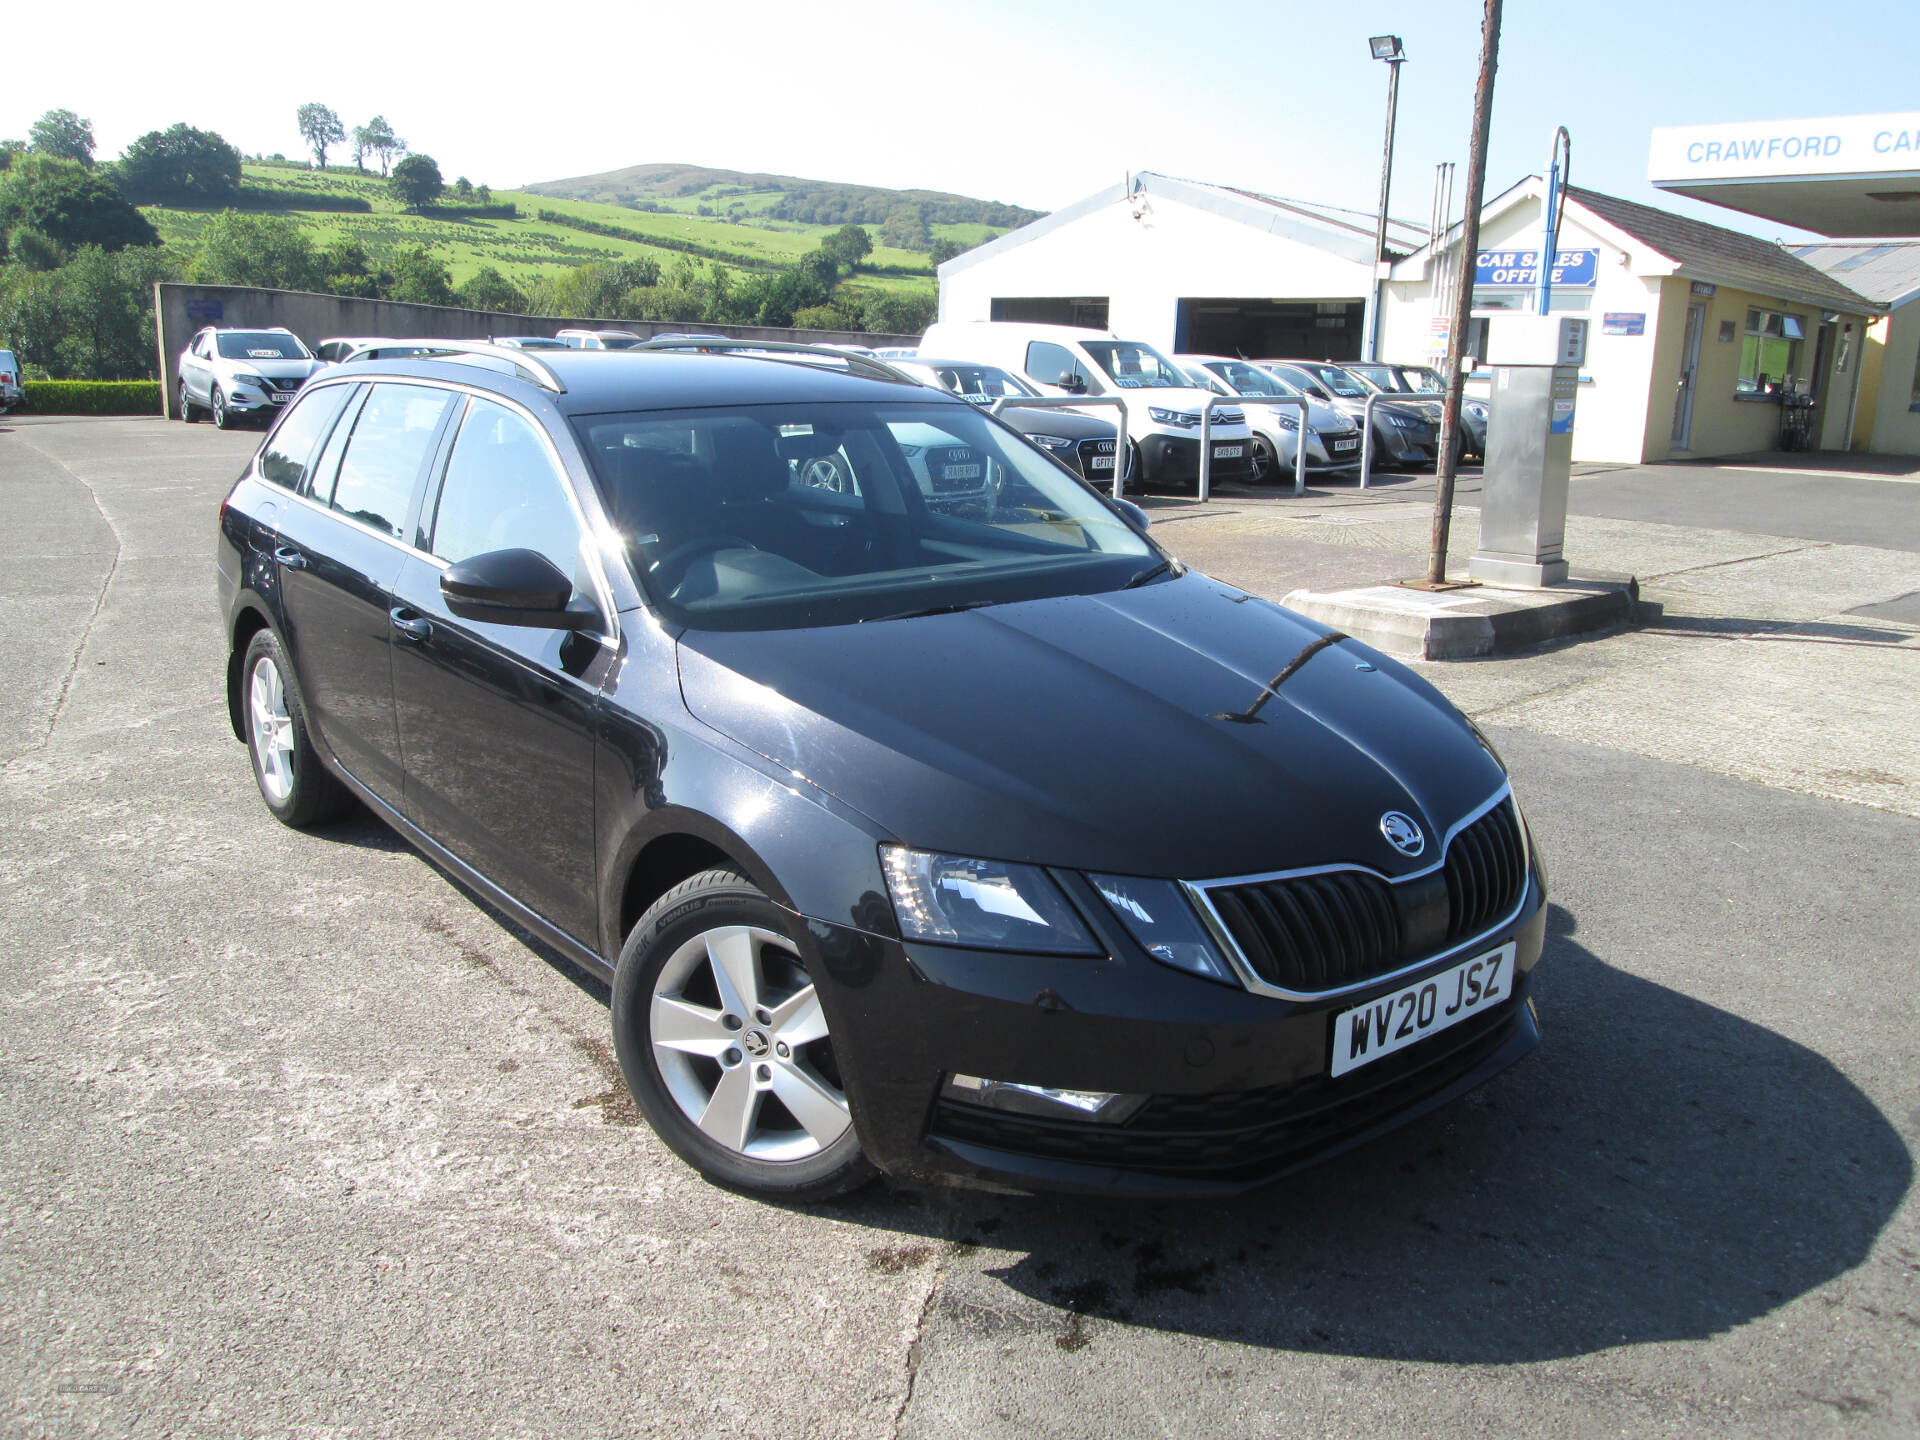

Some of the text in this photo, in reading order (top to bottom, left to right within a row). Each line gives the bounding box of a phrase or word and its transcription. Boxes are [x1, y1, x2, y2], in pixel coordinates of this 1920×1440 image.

[1687, 135, 1842, 163] CRAWFORD
[1476, 253, 1515, 267] CAR
[1492, 268, 1564, 282] OFFIE
[1096, 457, 1111, 467] GF17
[1350, 952, 1503, 1059] WV20 JSZ
